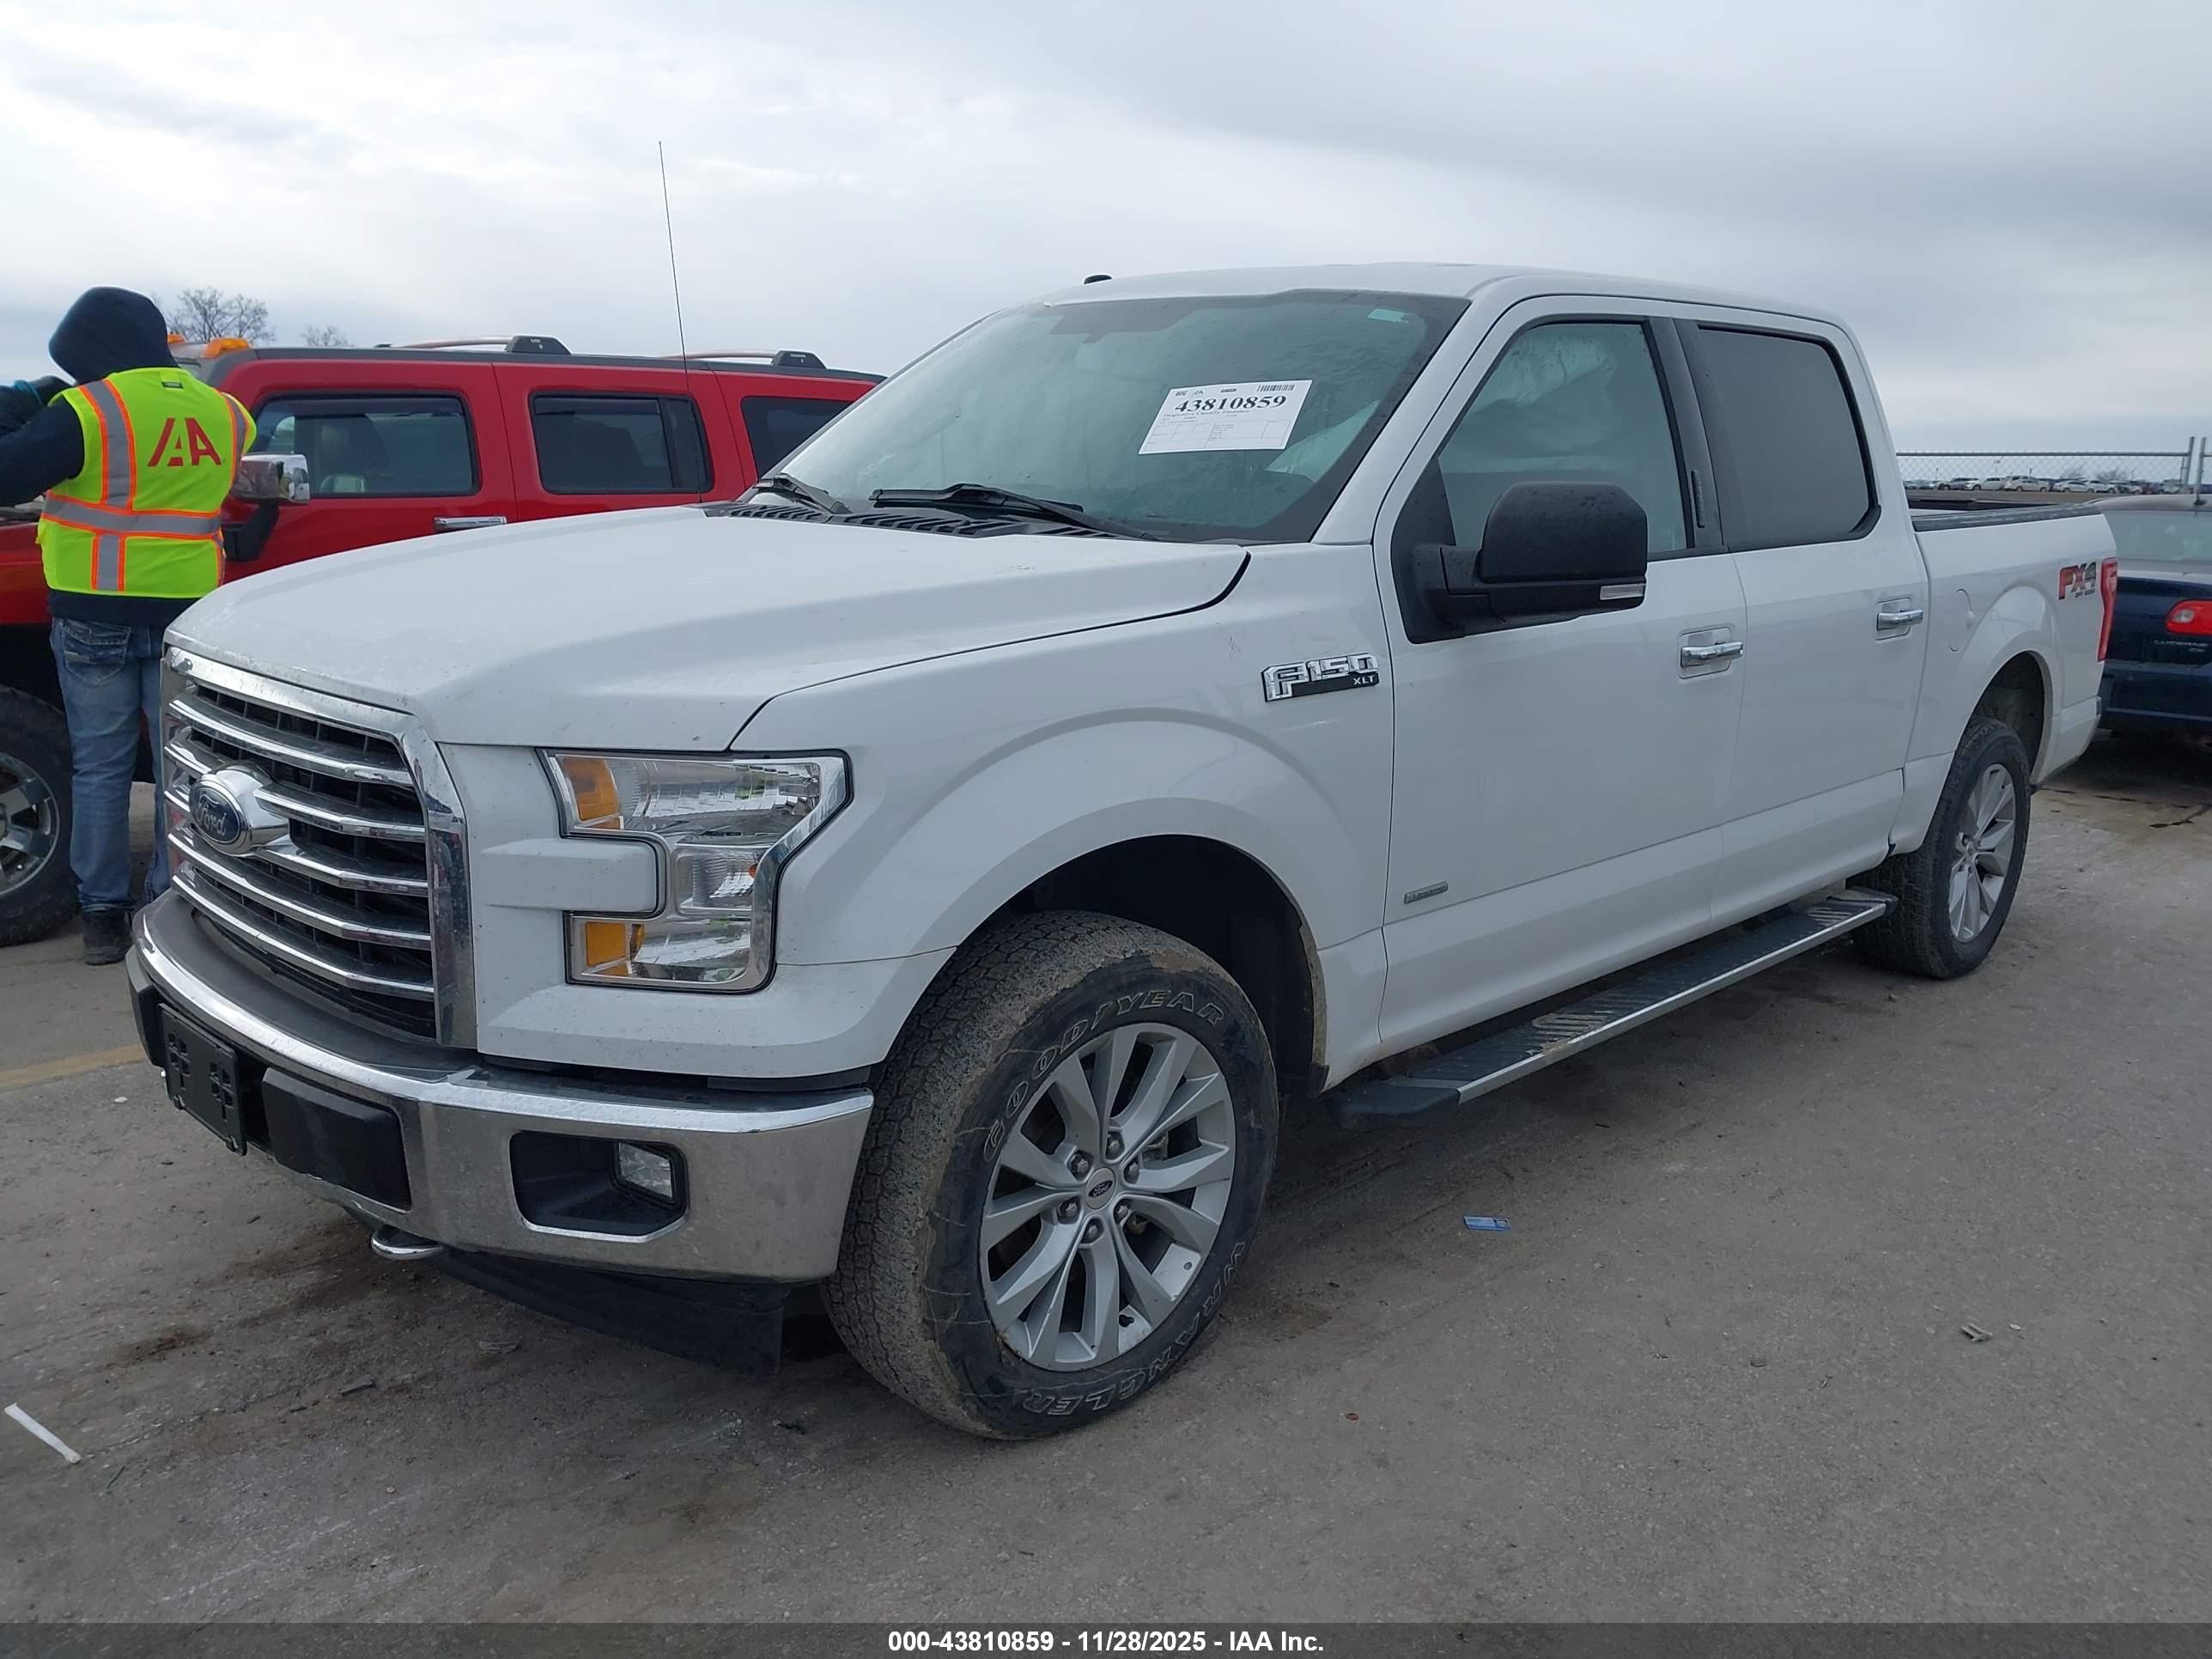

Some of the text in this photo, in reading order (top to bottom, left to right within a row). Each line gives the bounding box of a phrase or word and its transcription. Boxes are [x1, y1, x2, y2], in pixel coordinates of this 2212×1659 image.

[1174, 395, 1286, 411] 43810859
[2058, 561, 2097, 600] FX4
[1352, 675, 1376, 686] XLT
[193, 793, 228, 841] Ford
[981, 988, 1225, 1164] GOODYEAR
[1022, 1242, 1246, 1416] WRANGLER
